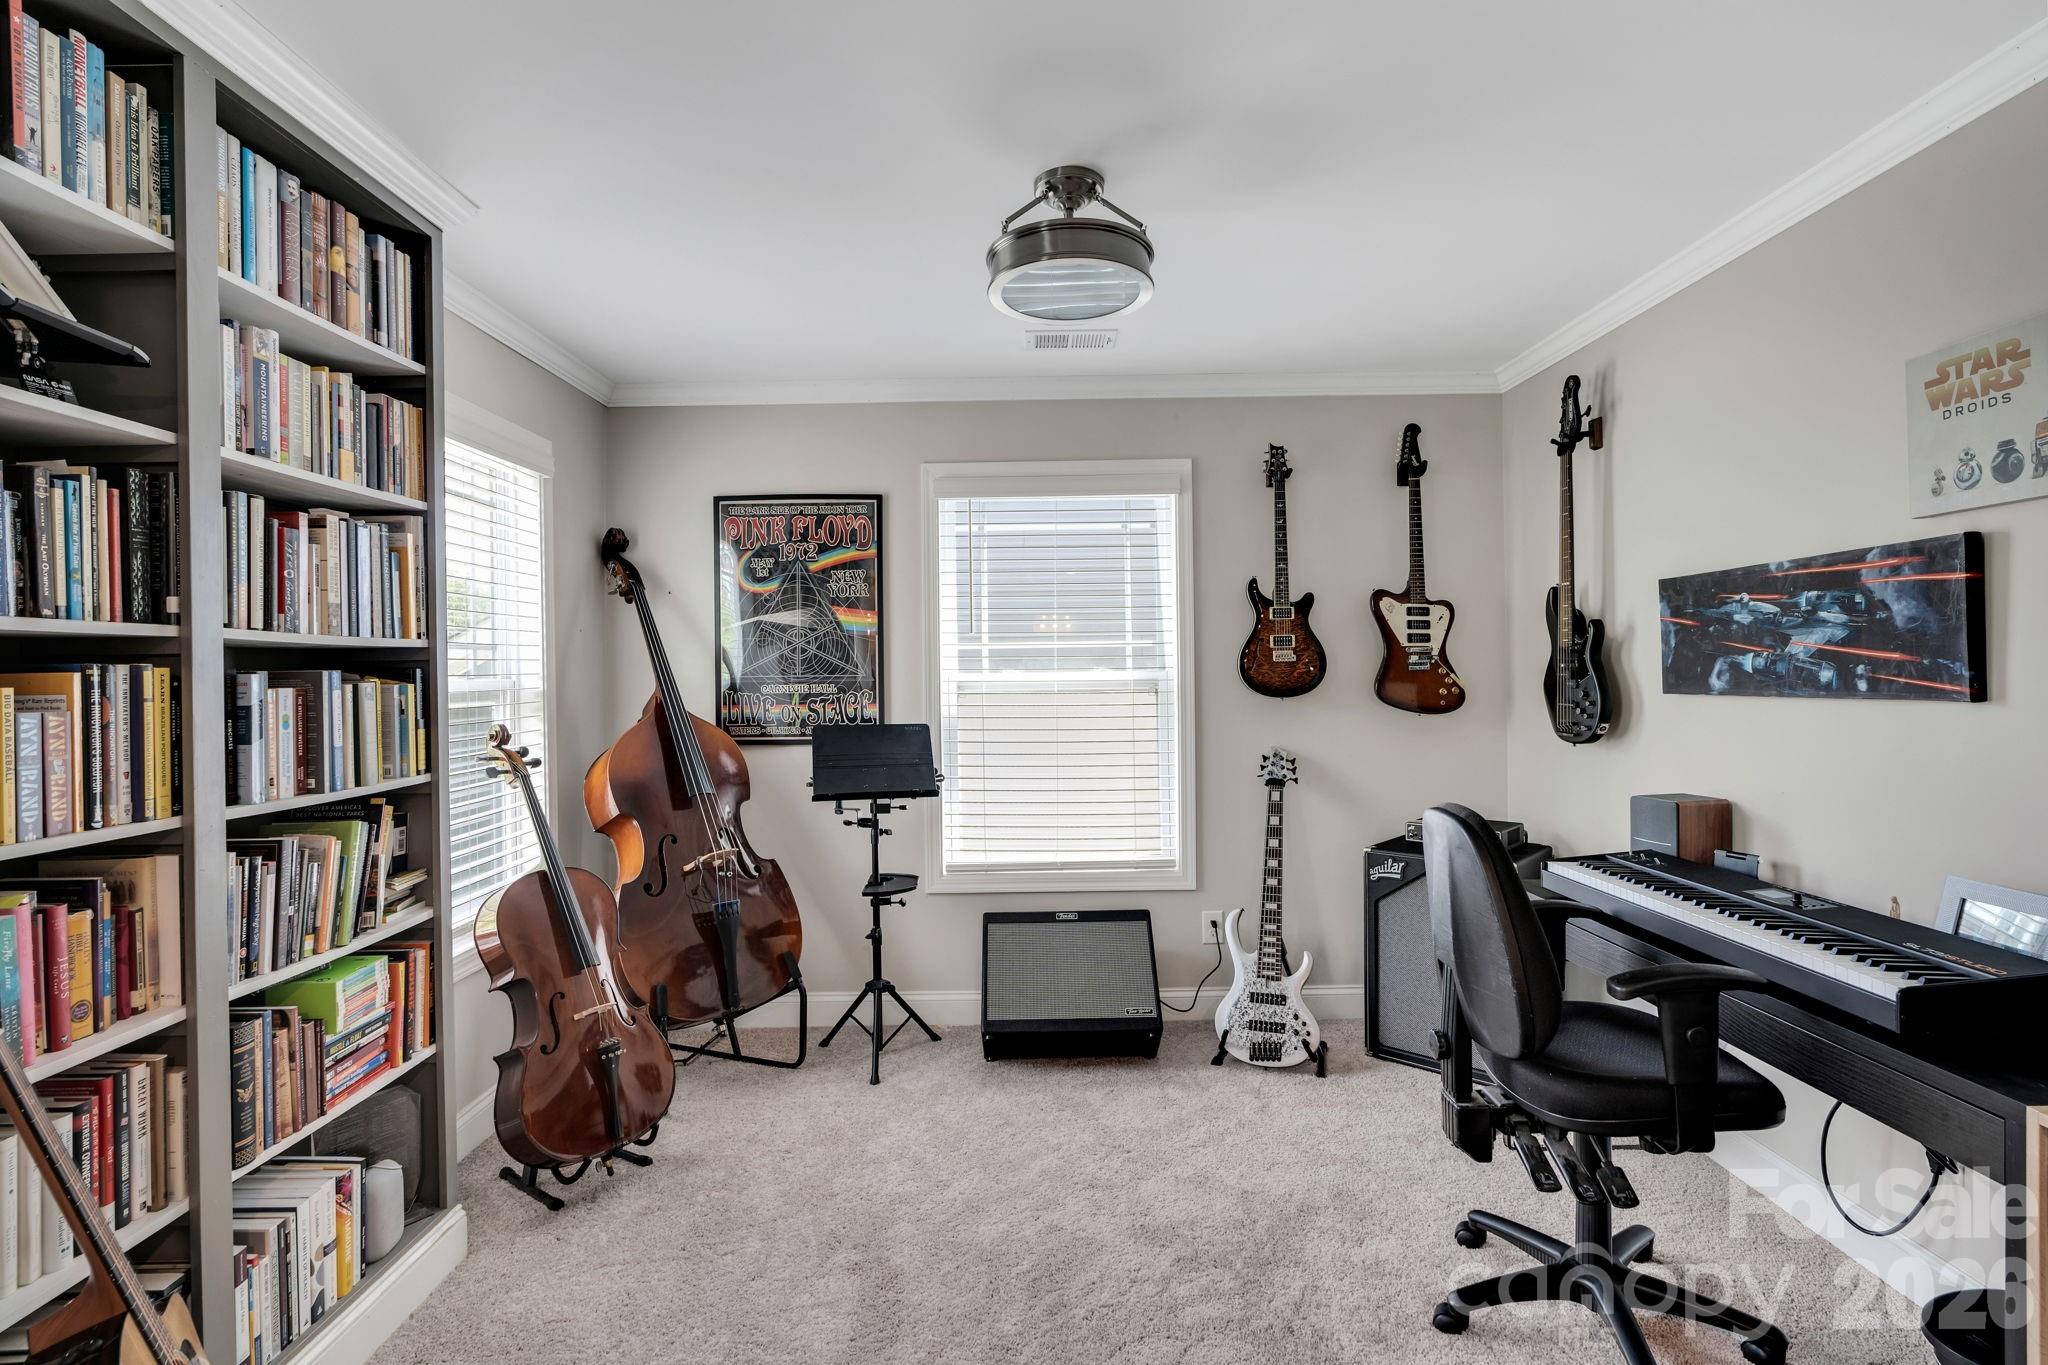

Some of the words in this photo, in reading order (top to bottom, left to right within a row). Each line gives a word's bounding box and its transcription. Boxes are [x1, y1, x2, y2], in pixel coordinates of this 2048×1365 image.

[24, 39, 39, 111] MOUNTAINS
[74, 36, 88, 108] MONEYBALL
[114, 120, 122, 156] Ordinary
[130, 120, 140, 139] Idea
[131, 141, 140, 150] Is
[151, 126, 161, 148] OAK
[130, 152, 140, 190] Brilliant
[151, 150, 161, 193] PAPERS
[217, 137, 227, 193] INNOVATORS
[218, 195, 226, 220] Walter
[1924, 336, 2031, 390] STAR
[22, 373, 50, 386] NASA
[1924, 358, 2031, 412] WARS
[259, 362, 269, 442] MOUNTAINEERING
[1943, 392, 2012, 421] DROIDS
[236, 417, 242, 425] OF
[72, 502, 80, 523] Catch
[728, 505, 745, 515] THE
[745, 505, 769, 515] DARK
[770, 505, 789, 515] SIDE
[790, 505, 801, 515] OF
[801, 504, 818, 515] THE
[819, 504, 844, 515] MOON
[845, 504, 868, 514] TOUR
[72, 523, 80, 533] Me
[724, 515, 787, 550] PINK
[791, 514, 873, 550] FLOYD
[40, 545, 49, 562] LAST
[750, 557, 775, 568] MAY
[778, 542, 818, 561] 1972
[41, 562, 51, 596] OLYMPIAN
[756, 567, 770, 577] 1st
[830, 569, 866, 584] NEW
[827, 582, 869, 597] YORK
[3, 694, 13, 710] BIG
[90, 689, 103, 705] THE
[760, 684, 809, 694] CARNEGIE
[811, 683, 838, 694] HALL
[122, 688, 130, 733] INNOVATOR'S
[724, 690, 776, 726] LIVE
[780, 705, 801, 724] ON
[806, 688, 874, 726] STAGE
[4, 711, 13, 736] DATA
[19, 717, 38, 758] AYN
[47, 715, 67, 752] AYN
[90, 705, 103, 755] INNOVATOR'S
[729, 726, 761, 736] WATERS
[766, 726, 801, 736] GILMOUR
[4, 736, 14, 784] BASEBALL
[91, 757, 103, 794] SOLUTION
[20, 769, 38, 824] RAND
[49, 772, 67, 822] RAND
[1370, 858, 1405, 884] aguilar
[252, 913, 260, 934] Night
[2, 929, 12, 962] Firefly
[3, 965, 13, 990] Lane
[58, 956, 69, 1000] JESUS
[1943, 953, 2008, 976] STUDIO
[408, 962, 416, 1010] ENDURE
[12, 1004, 20, 1039] KRISTIN
[81, 1113, 91, 1152] EXTREME
[121, 1129, 130, 1142] THE
[121, 1142, 130, 1181] UNFINISHED
[121, 1181, 130, 1206] LEADER
[56, 1215, 66, 1247] Gladwell
[344, 1216, 353, 1264] IMMUNE
[272, 1294, 281, 1342] RUNNING
